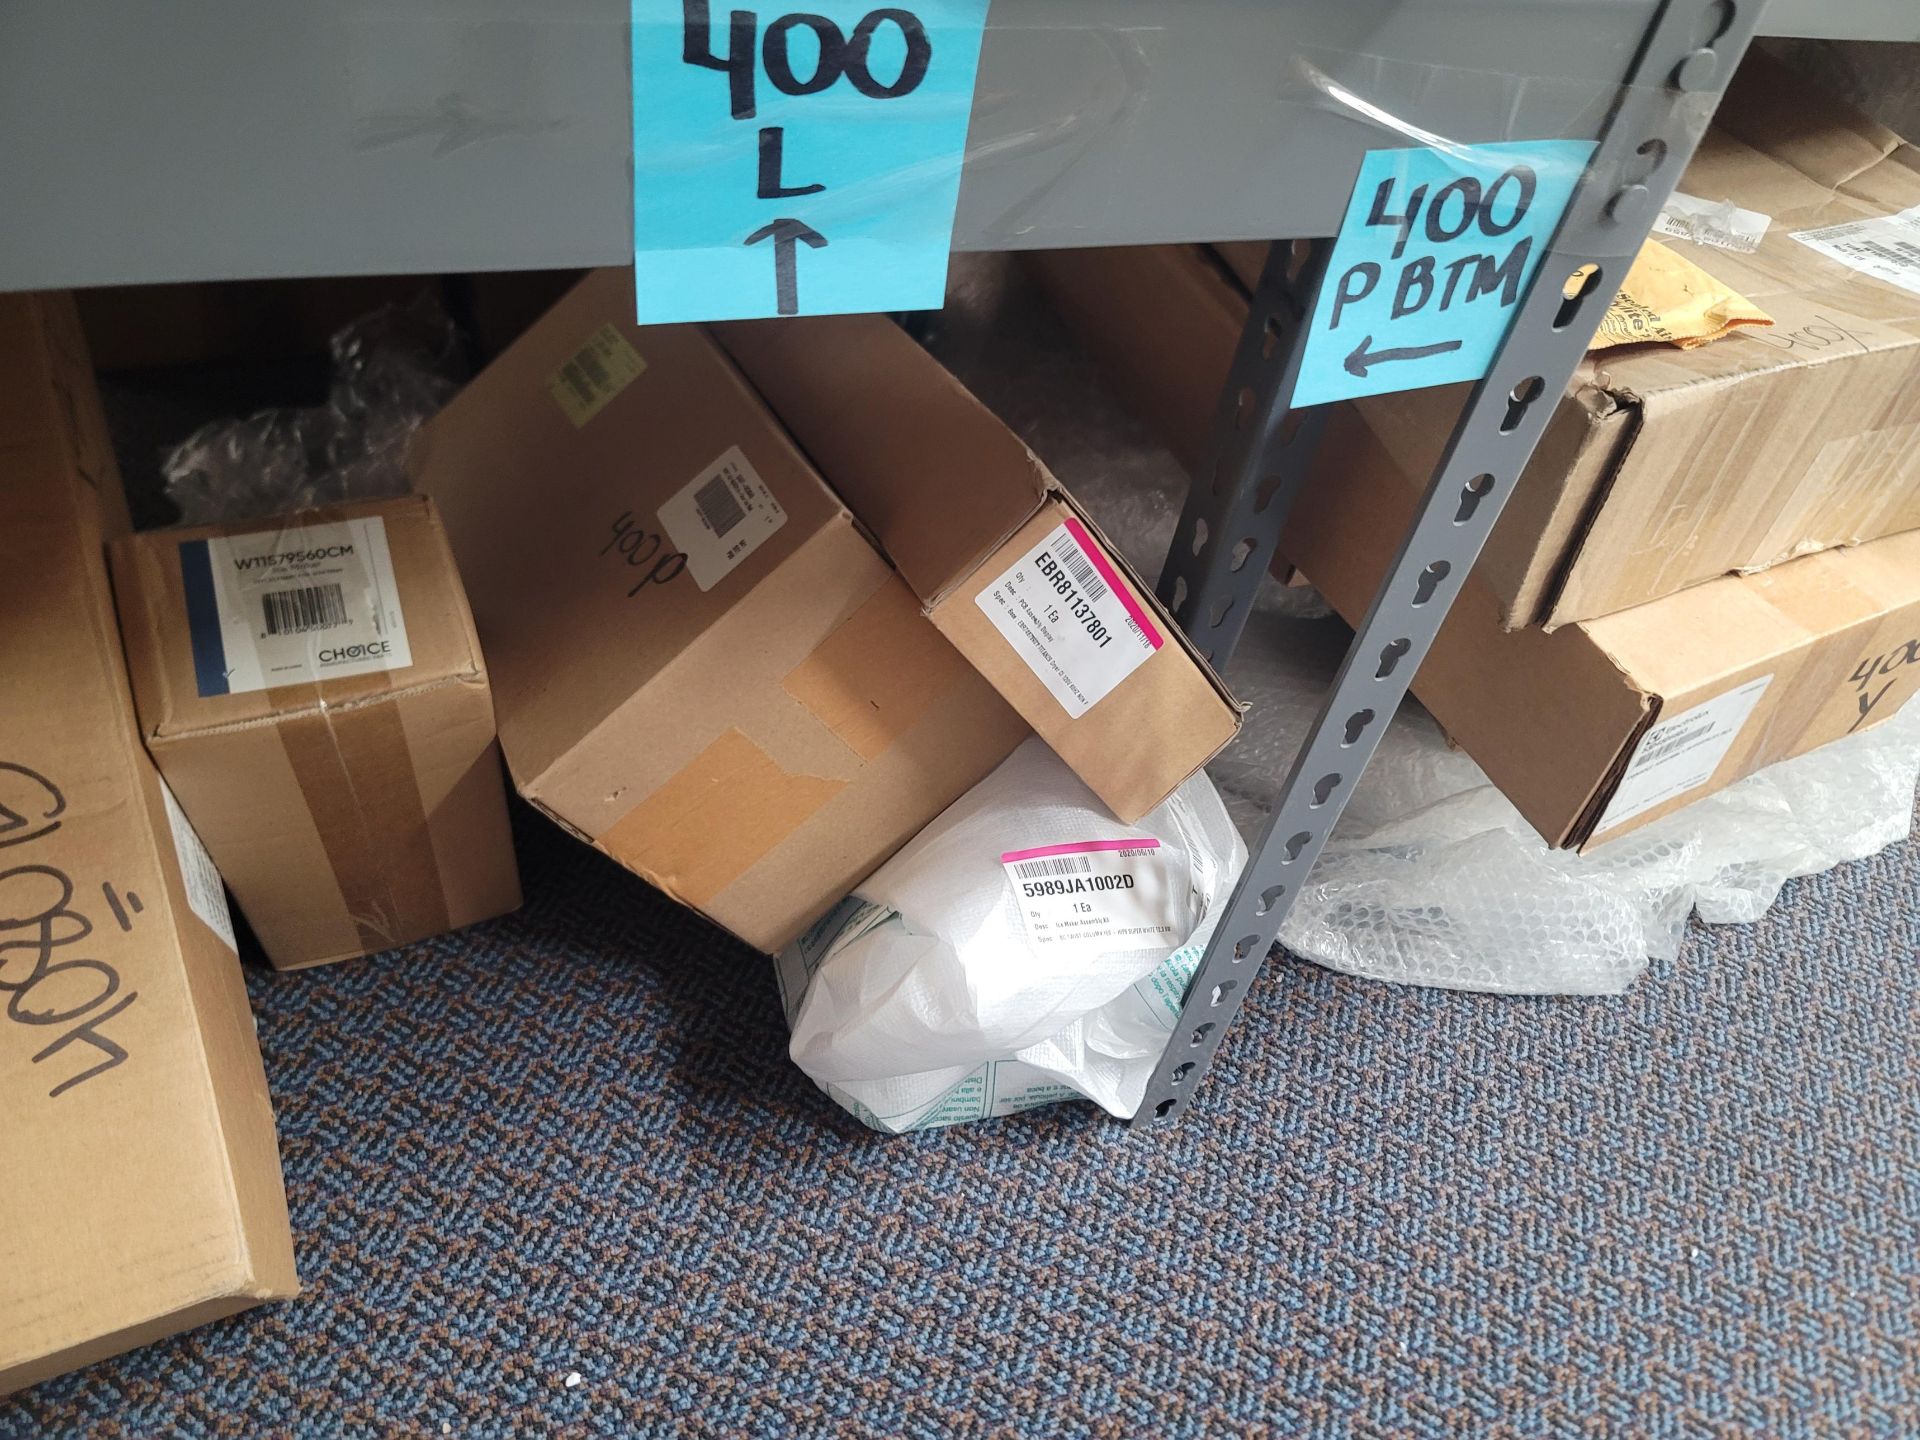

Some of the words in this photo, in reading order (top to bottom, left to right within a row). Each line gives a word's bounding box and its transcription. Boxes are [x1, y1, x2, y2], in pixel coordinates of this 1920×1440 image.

[683, 0, 932, 119] 400
[757, 127, 826, 198] L
[1366, 165, 1537, 260] 400
[1329, 262, 1381, 330] P
[1390, 236, 1533, 320] BTM
[234, 544, 354, 571] W11579560CM
[601, 510, 661, 566] 400
[1035, 552, 1112, 648] EBR81137801
[1044, 605, 1051, 614] 1
[1048, 610, 1059, 623] Ea
[319, 640, 392, 664] CHOICE
[1023, 874, 1135, 898] 5989JA1002D
[1073, 904, 1079, 914] 1
[1080, 902, 1092, 913] Ea
